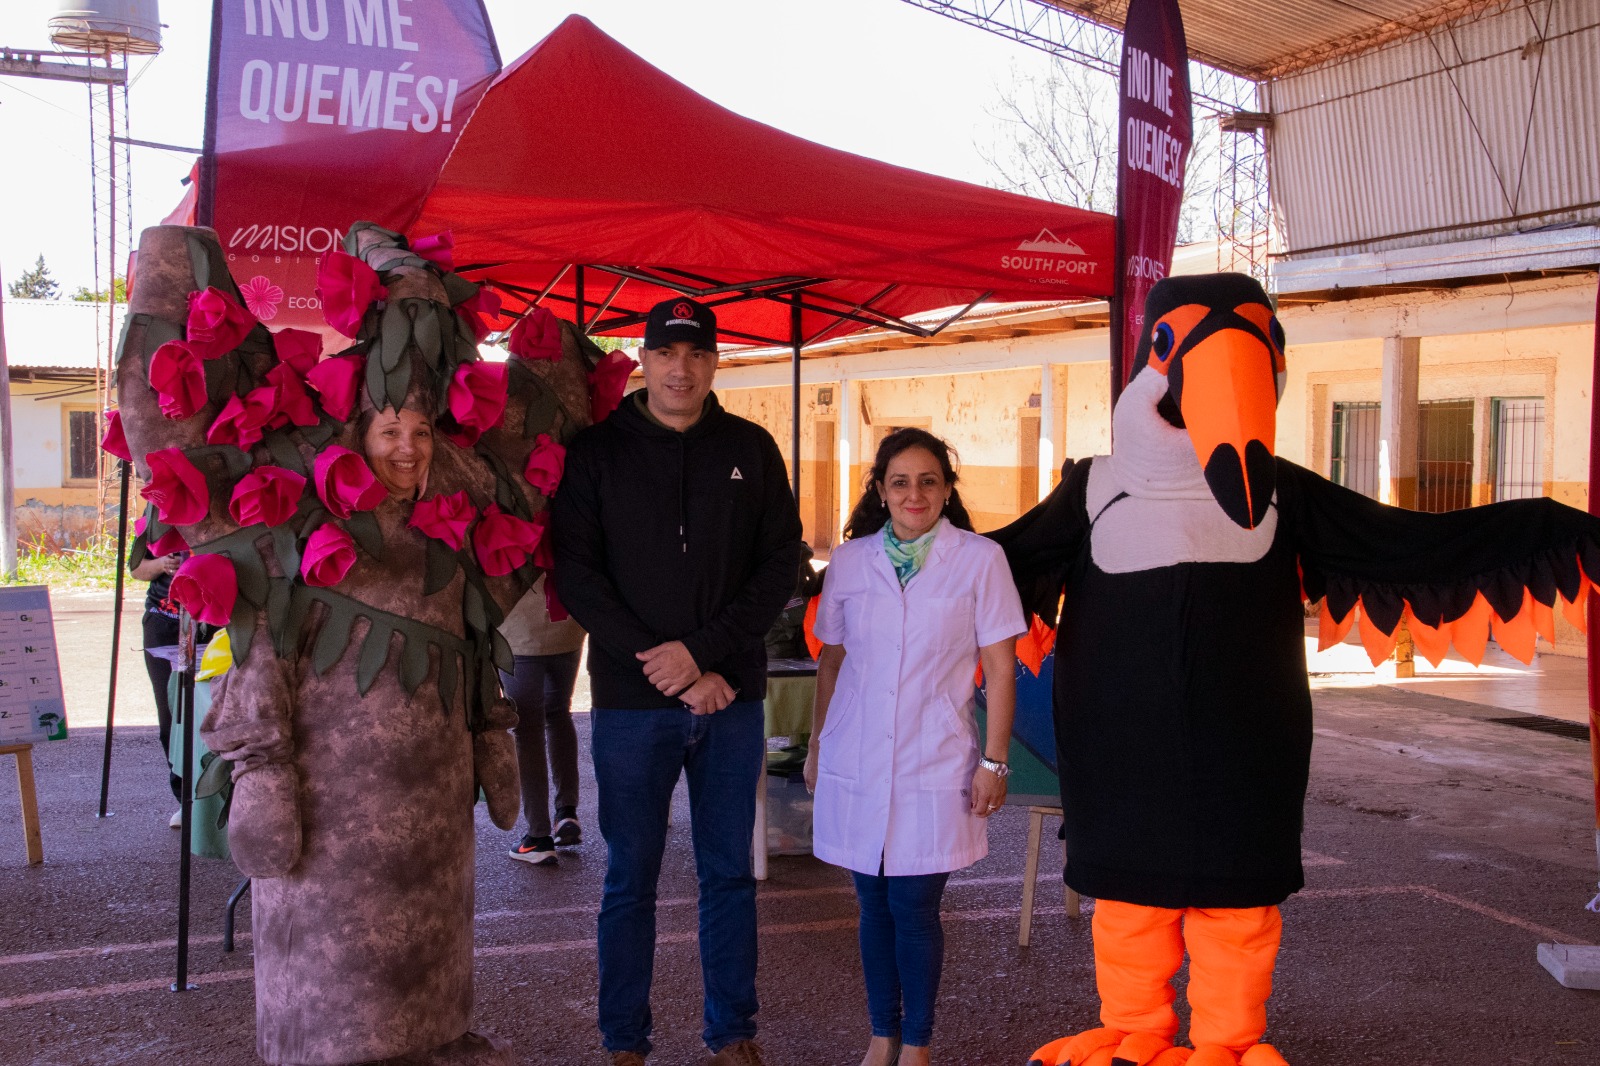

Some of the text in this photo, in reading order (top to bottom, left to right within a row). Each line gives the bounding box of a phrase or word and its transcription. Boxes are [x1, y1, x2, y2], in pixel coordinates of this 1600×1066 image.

[344, 0, 419, 51] ME
[239, 59, 459, 133] QUEMÉS!
[1127, 46, 1174, 118] ¡NO ME
[1127, 116, 1182, 188] QUEMÉS!
[1001, 255, 1098, 275] SOUTH PORT
